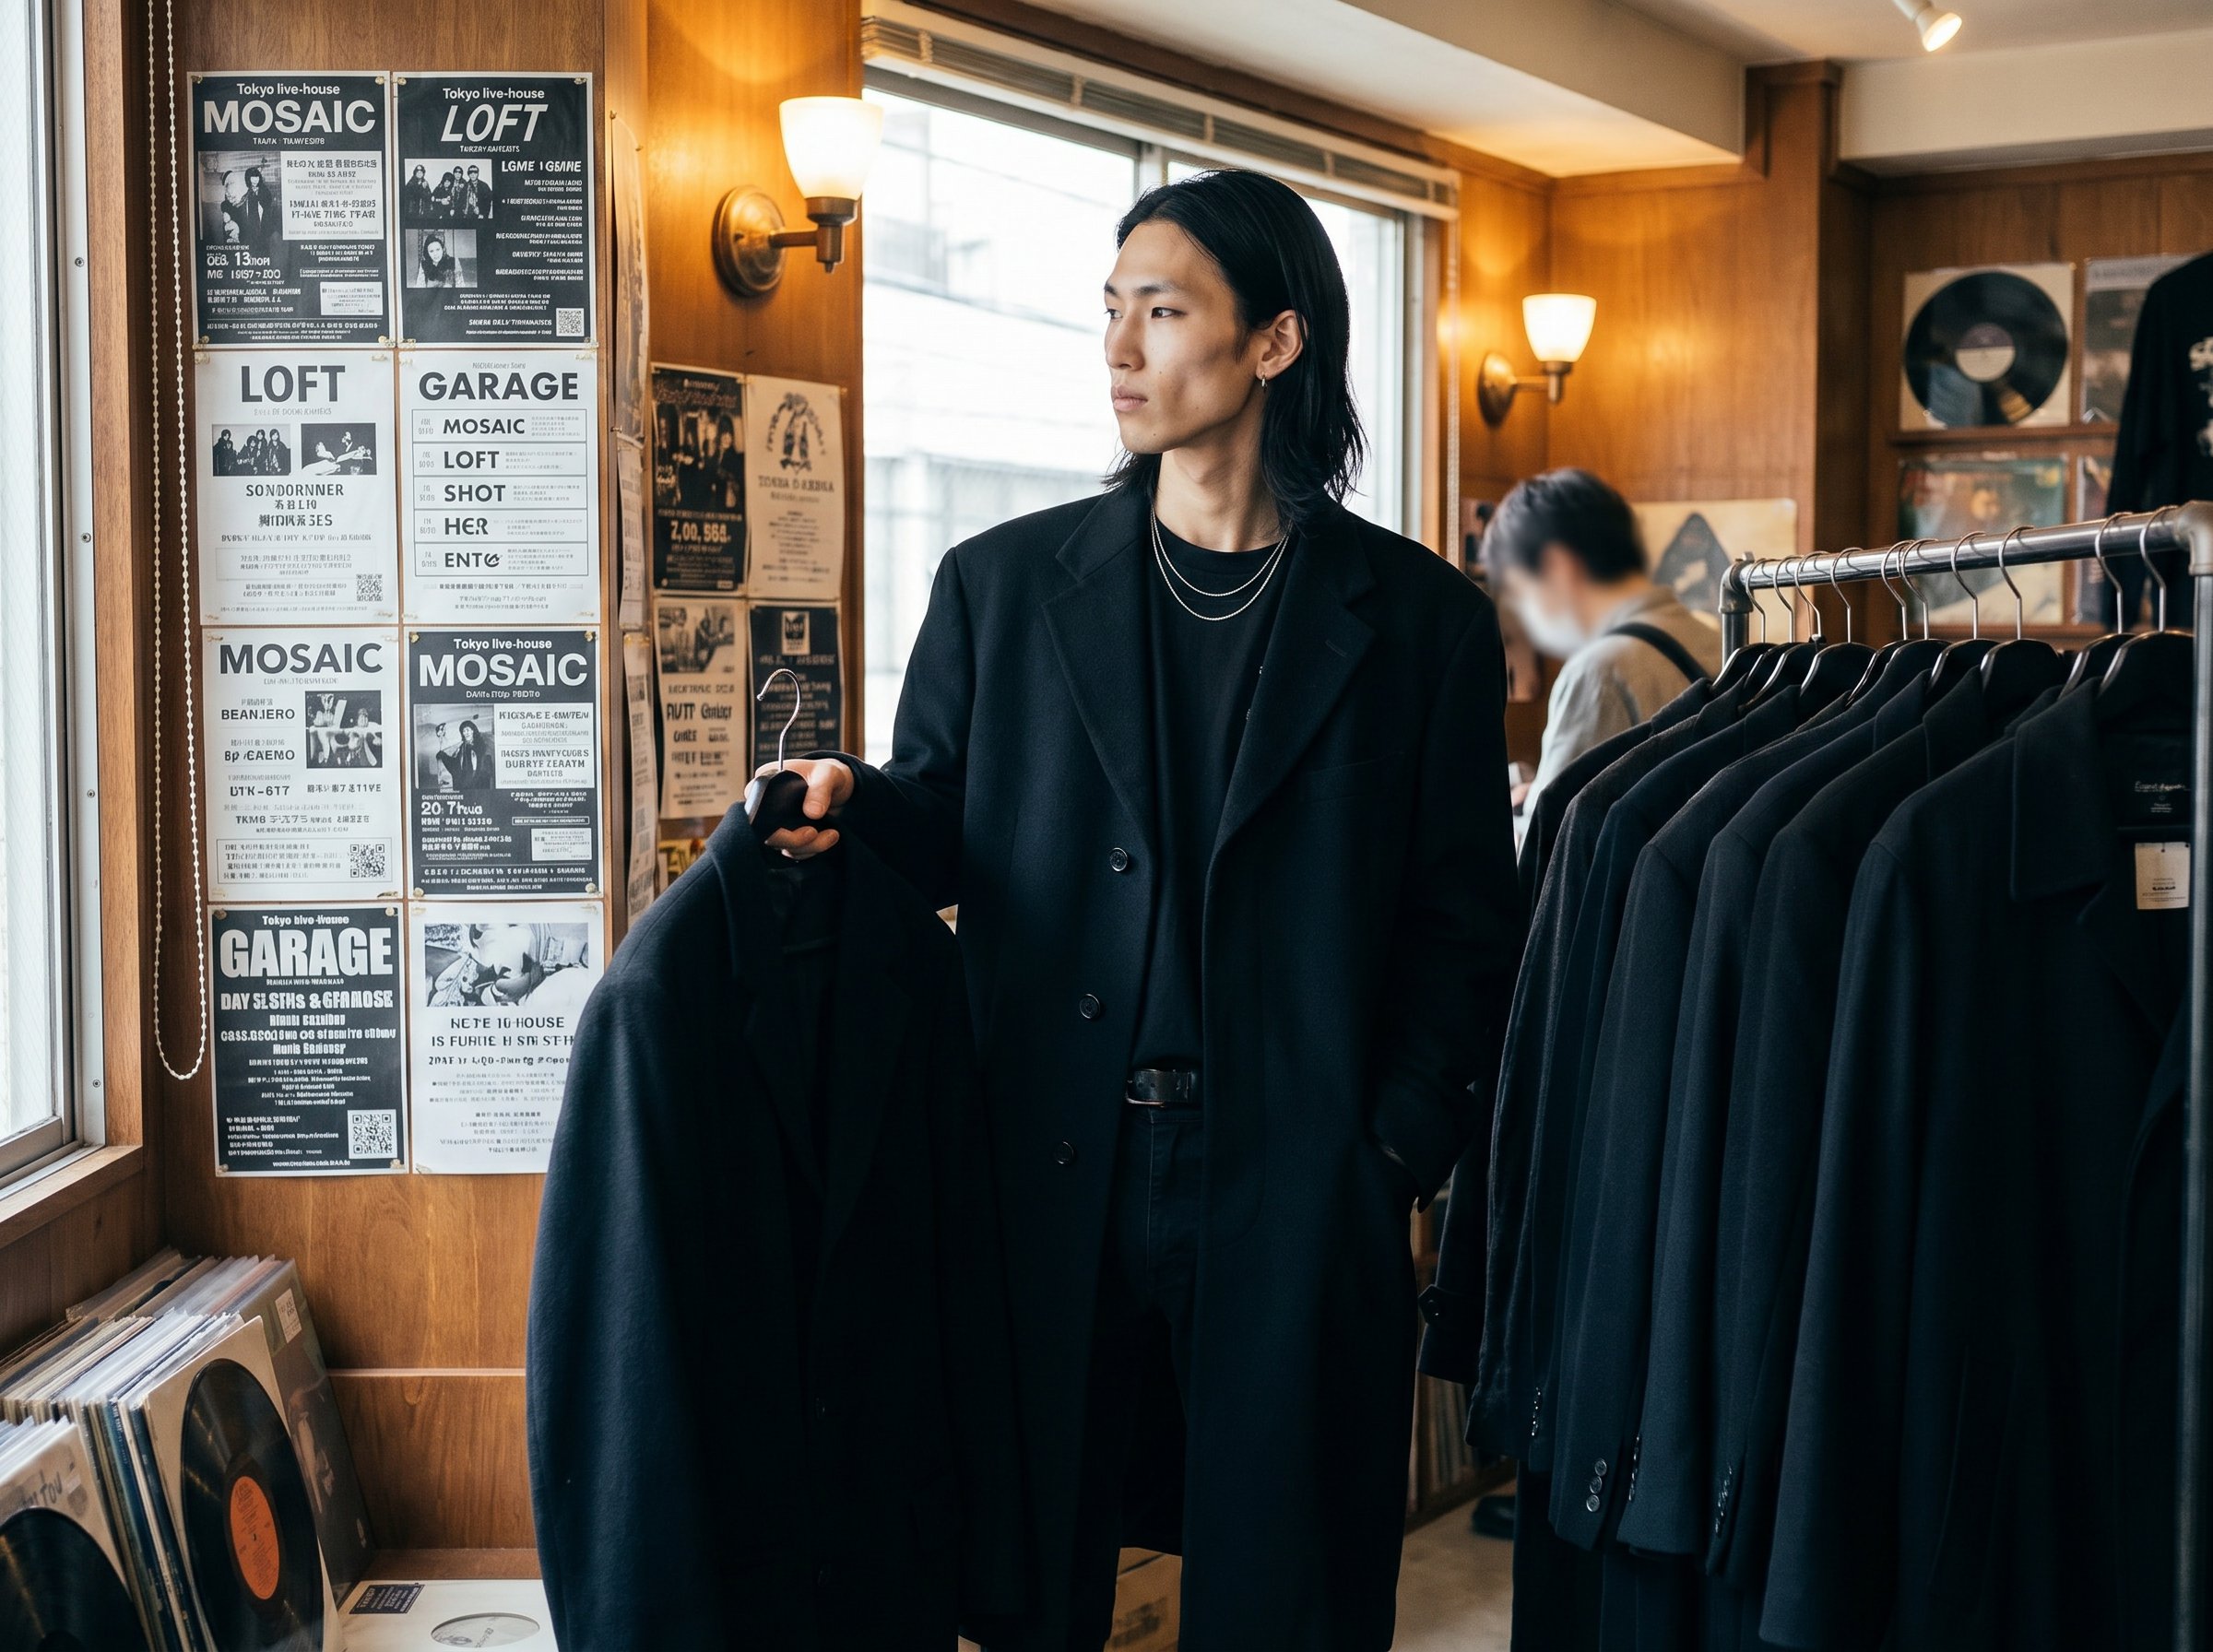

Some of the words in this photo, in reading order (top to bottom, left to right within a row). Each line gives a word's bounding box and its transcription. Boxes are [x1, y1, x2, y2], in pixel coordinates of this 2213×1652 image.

[237, 83, 274, 97] Tokyo
[278, 83, 340, 95] live-house
[443, 88, 479, 101] Tokyo
[482, 88, 544, 99] live-house
[204, 100, 375, 134] MOSAIC
[441, 104, 548, 142] LOFT
[242, 365, 346, 403] LOFT
[419, 372, 578, 401] GARAGE
[443, 419, 526, 434] MOSAIC
[444, 451, 500, 468] LOFT
[444, 485, 505, 502] SHOT
[454, 638, 490, 651] Tokyo
[491, 638, 552, 649] live-house
[220, 643, 383, 674] MOSAIC
[420, 654, 587, 687] MOSAIC
[263, 915, 291, 926] Tokyo
[220, 927, 393, 977] GARAGE
